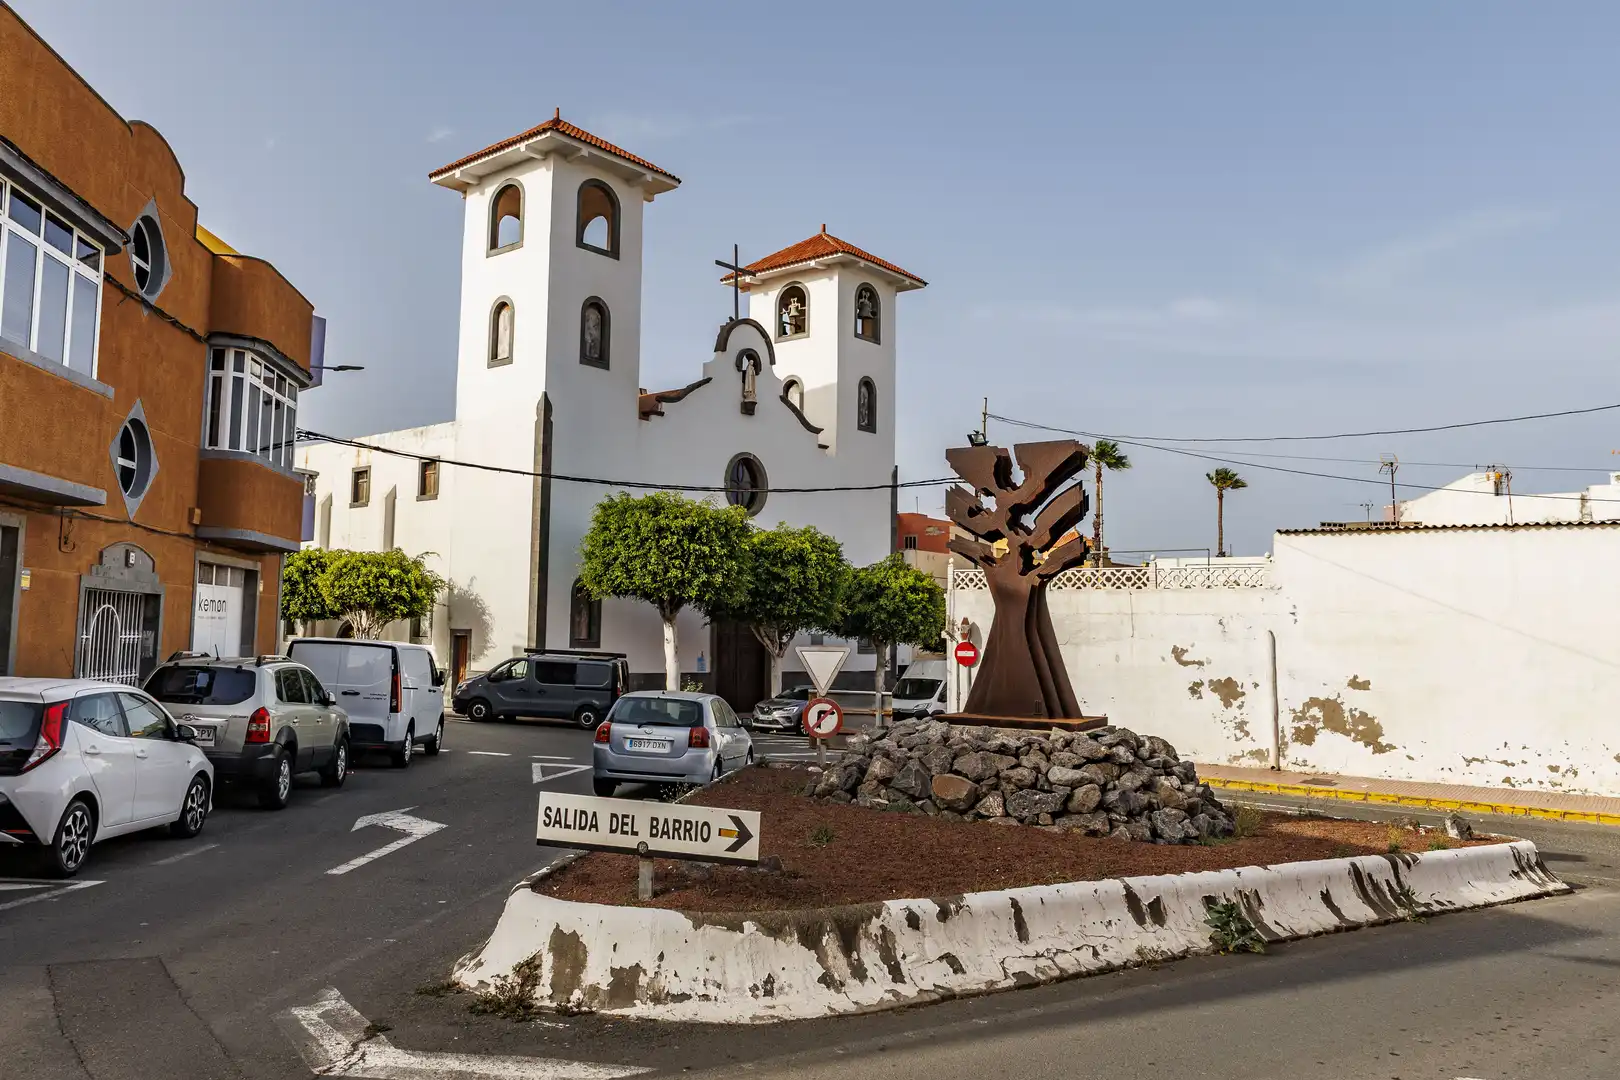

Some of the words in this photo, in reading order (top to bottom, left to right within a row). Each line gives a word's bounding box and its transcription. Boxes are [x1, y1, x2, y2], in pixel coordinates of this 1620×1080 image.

[633, 740, 651, 749] 6917
[652, 741, 667, 750] DXN
[543, 806, 599, 833] SALIDA
[609, 812, 639, 837] DEL
[649, 816, 711, 843] BARRIO
